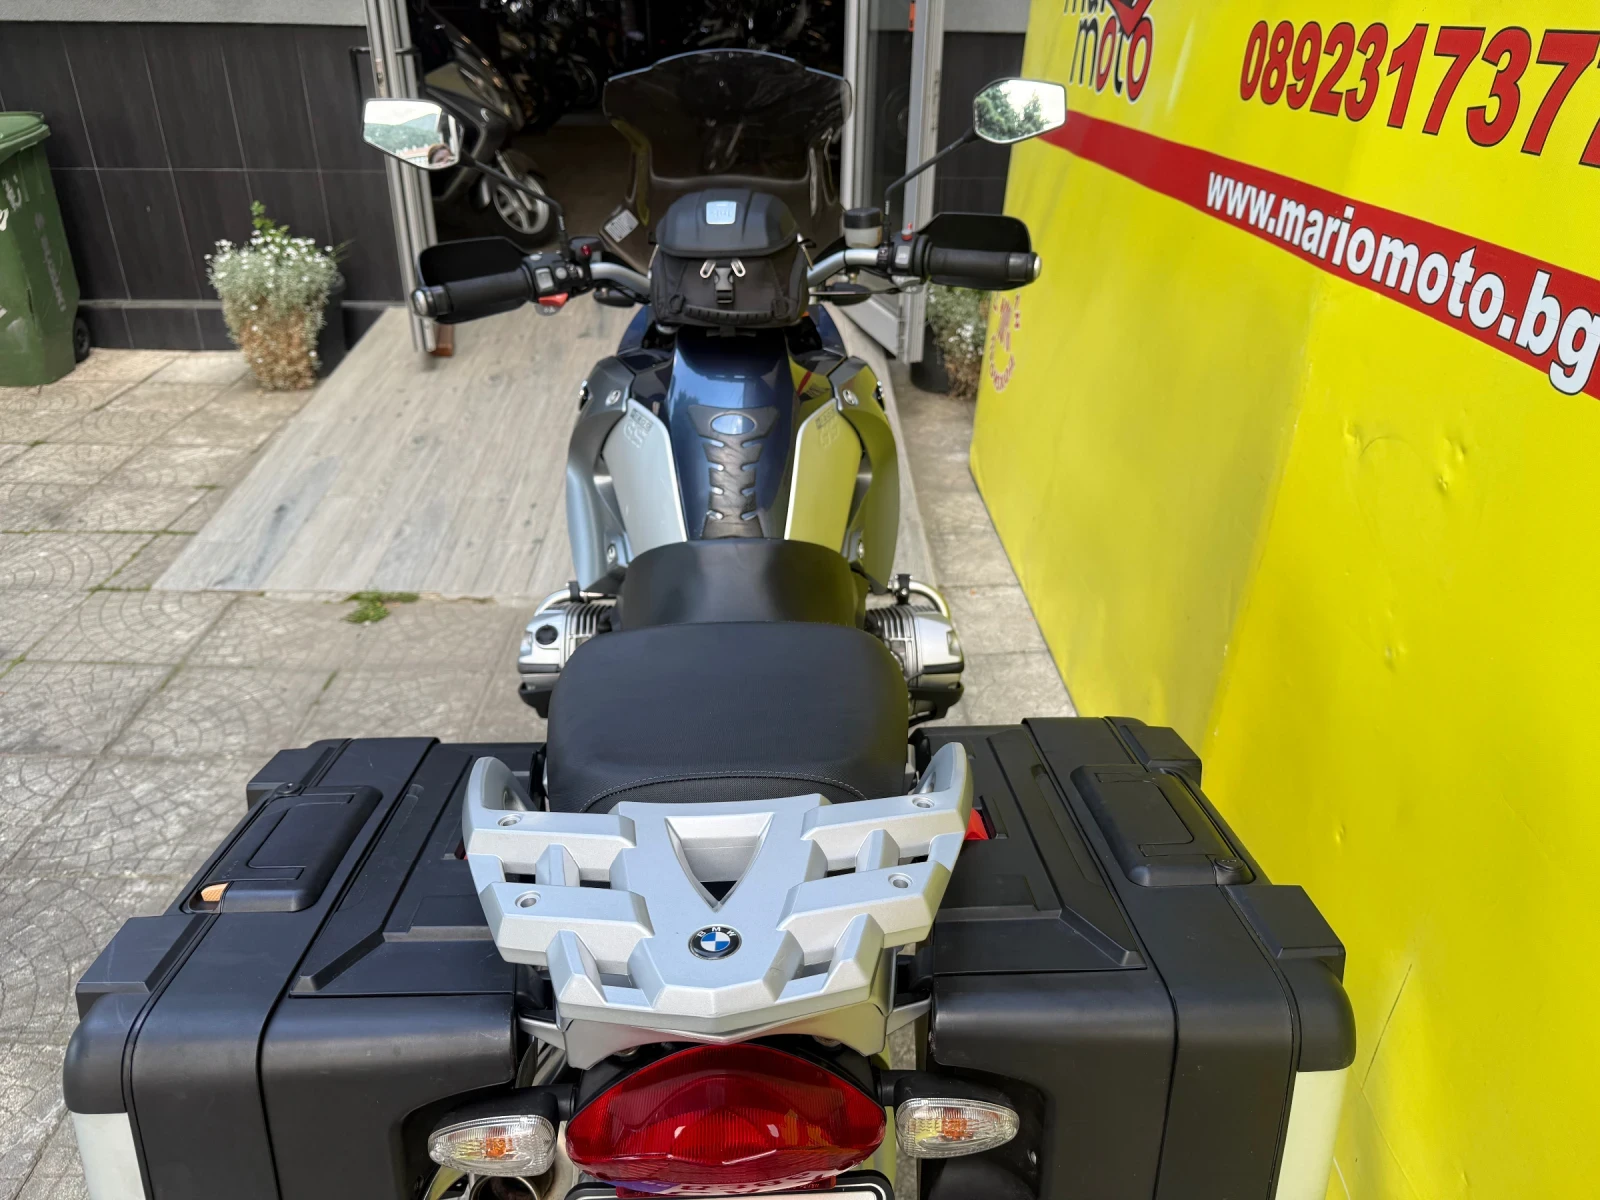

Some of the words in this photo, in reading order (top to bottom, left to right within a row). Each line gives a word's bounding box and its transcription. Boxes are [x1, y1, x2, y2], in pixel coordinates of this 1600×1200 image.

[1068, 16, 1154, 103] moto
[1206, 171, 1600, 396] www.mariomoto.bg
[696, 926, 737, 938] BMW
